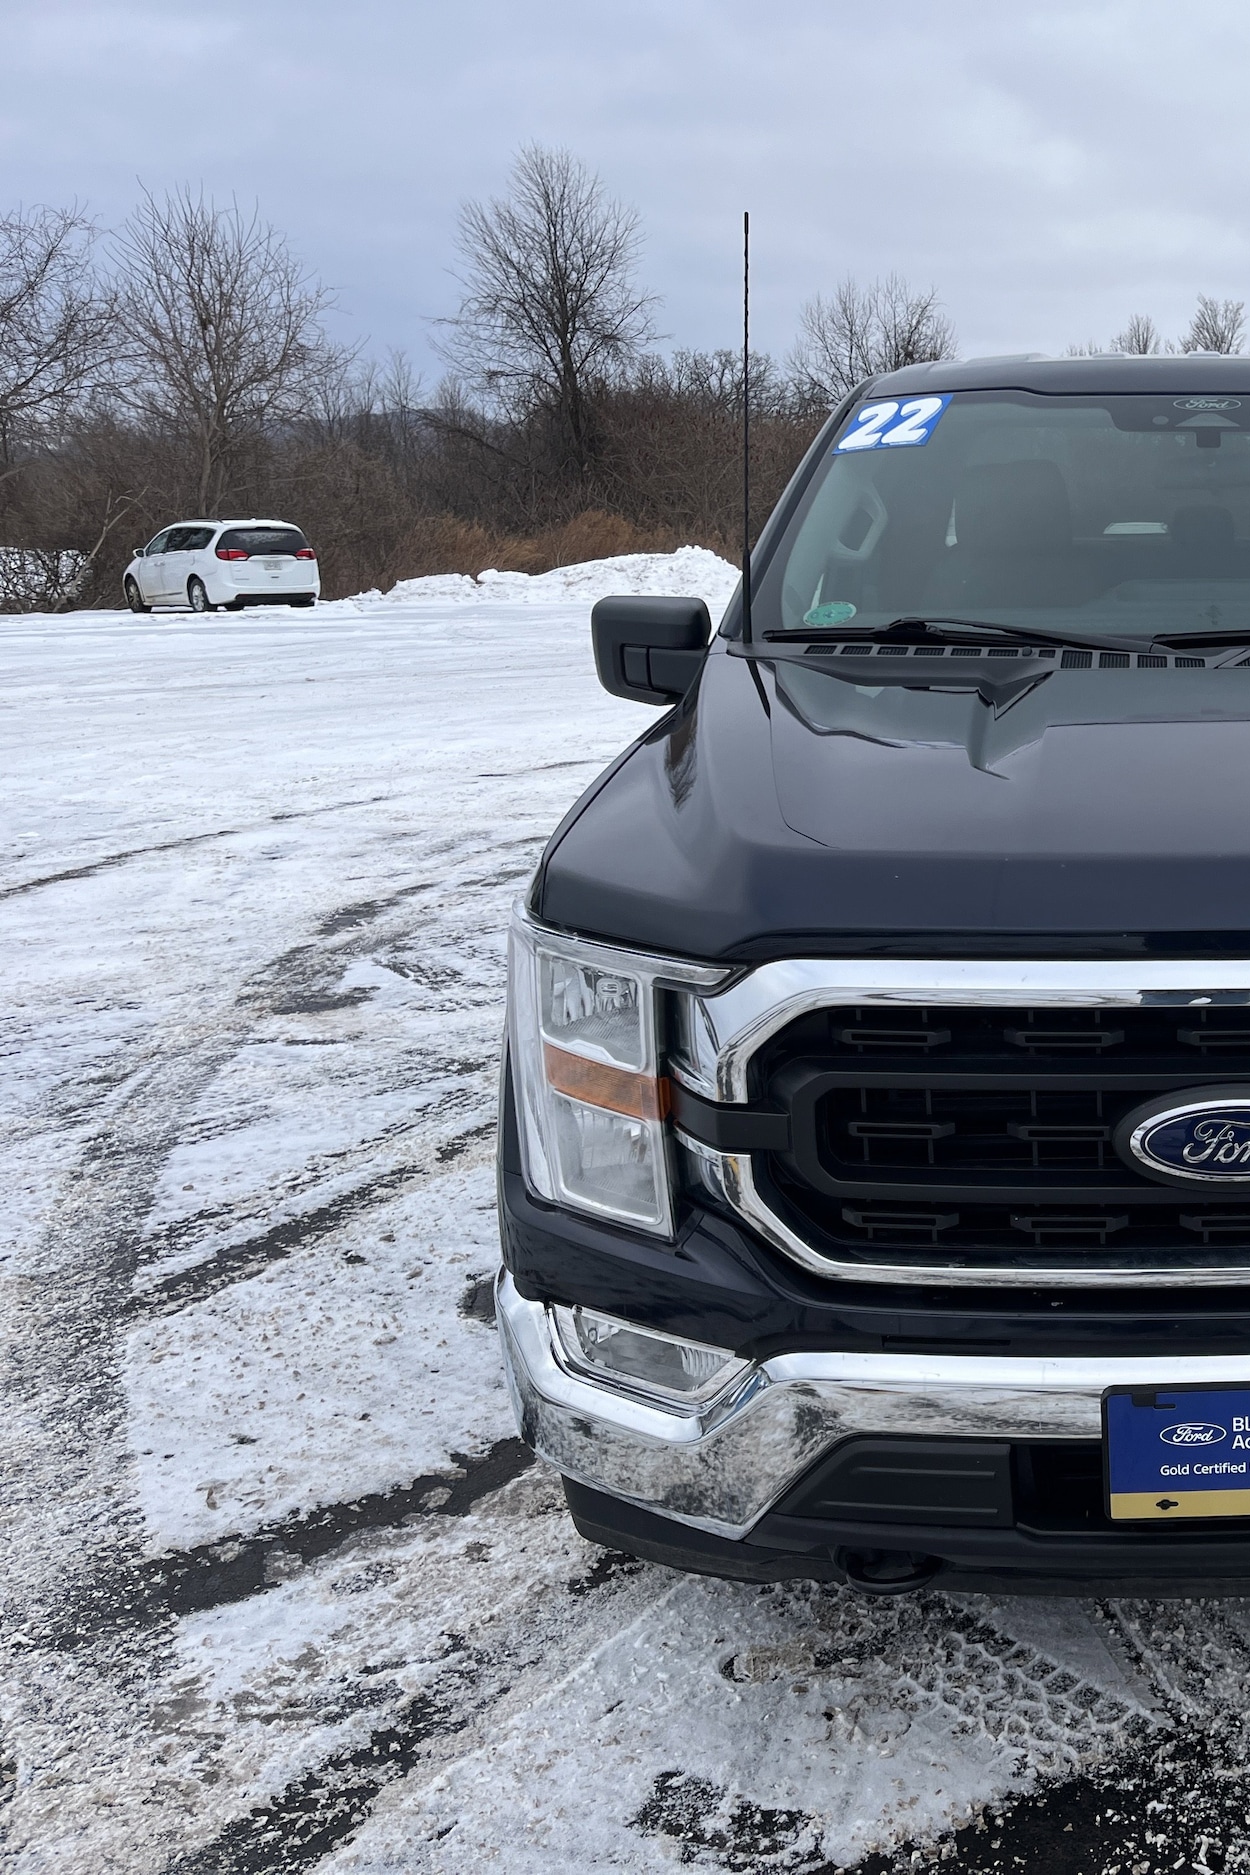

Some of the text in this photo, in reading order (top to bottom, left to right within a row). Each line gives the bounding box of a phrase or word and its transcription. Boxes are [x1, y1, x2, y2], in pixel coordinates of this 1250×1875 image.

[1185, 399, 1229, 409] Ford
[838, 397, 943, 450] 22
[1172, 1426, 1214, 1443] Ford
[1160, 1464, 1190, 1476] Gold
[1193, 1461, 1247, 1475] Certified
